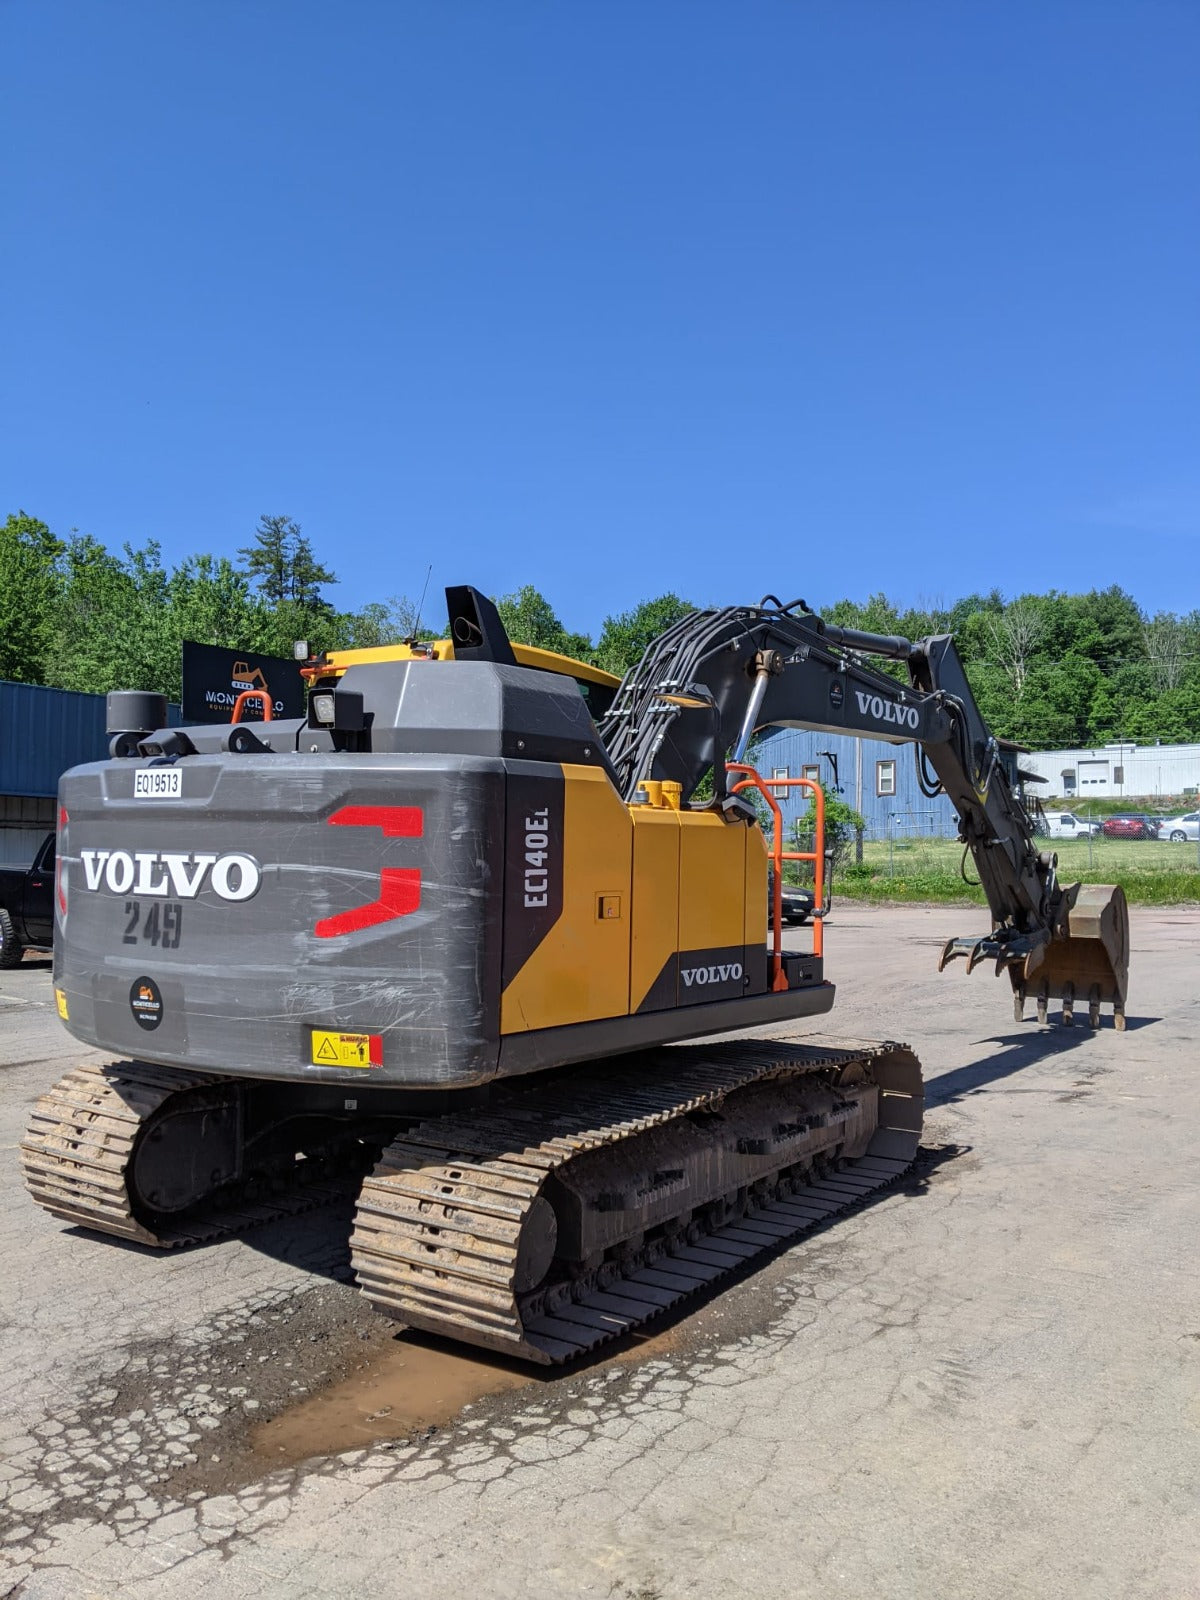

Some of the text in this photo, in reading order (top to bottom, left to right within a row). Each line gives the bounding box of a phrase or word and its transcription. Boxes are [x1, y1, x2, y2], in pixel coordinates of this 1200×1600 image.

[205, 690, 284, 712] MONICEO
[209, 704, 281, 718] EQUIPT COMNY
[855, 690, 920, 729] VOLVO
[136, 774, 178, 794] EQ19513
[80, 850, 260, 901] VOLVO
[122, 901, 183, 949] 249
[680, 963, 743, 987] VOLVO
